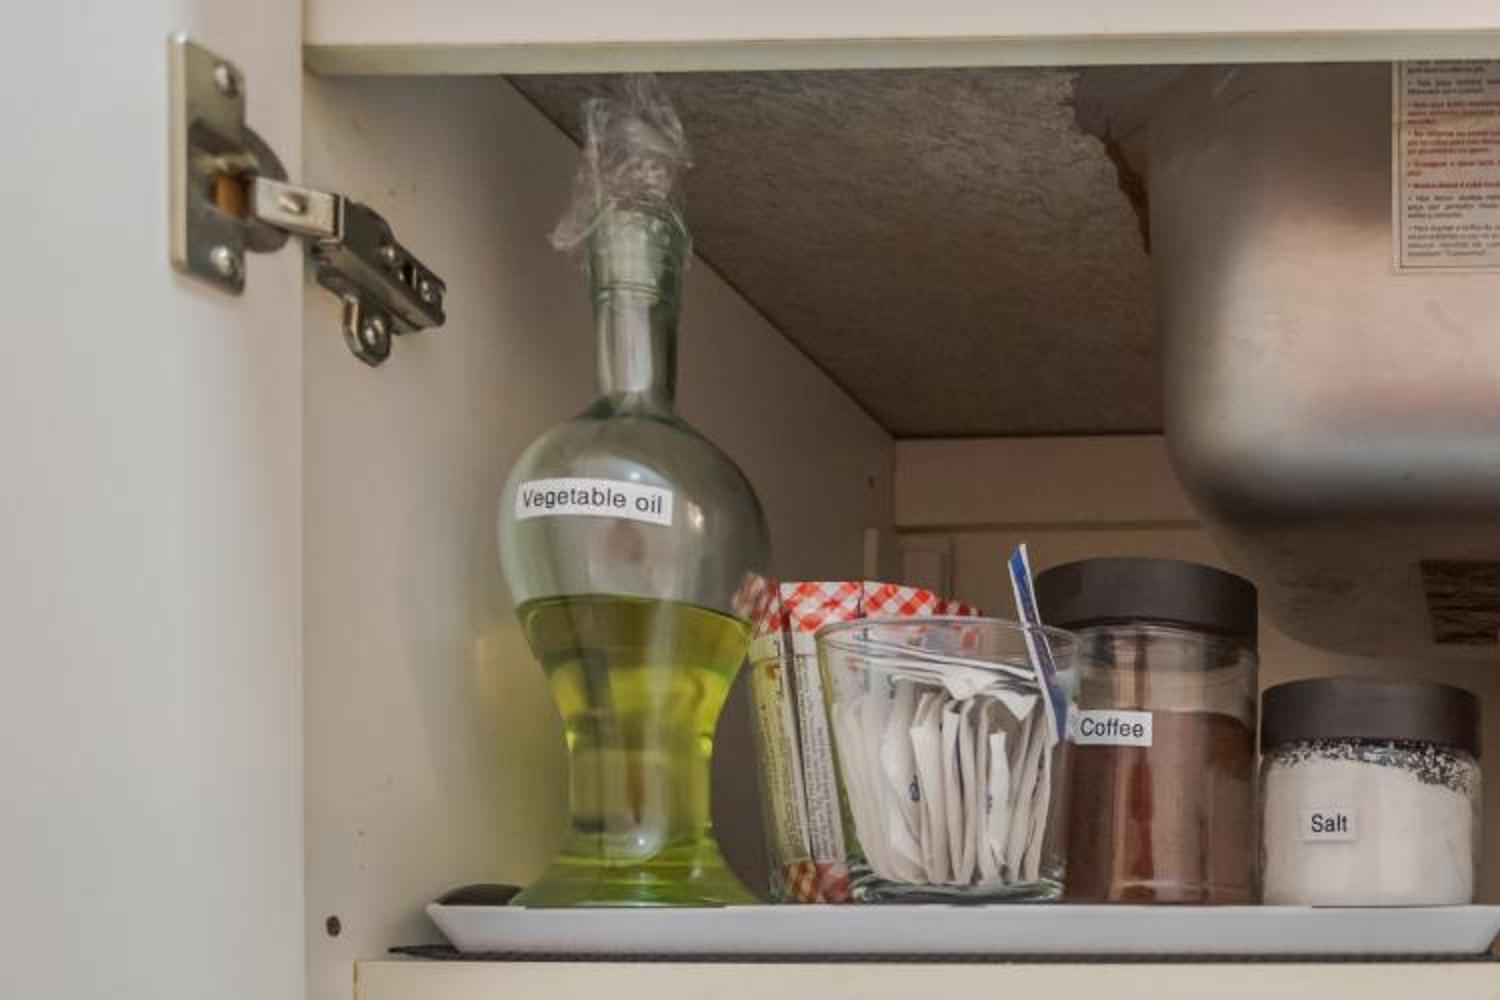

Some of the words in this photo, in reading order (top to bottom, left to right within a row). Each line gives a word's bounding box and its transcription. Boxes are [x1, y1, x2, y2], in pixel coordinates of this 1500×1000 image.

[522, 488, 627, 509] Vegetable
[634, 495, 663, 514] oil
[1080, 717, 1144, 738] Coffee
[1311, 813, 1348, 834] Salt
